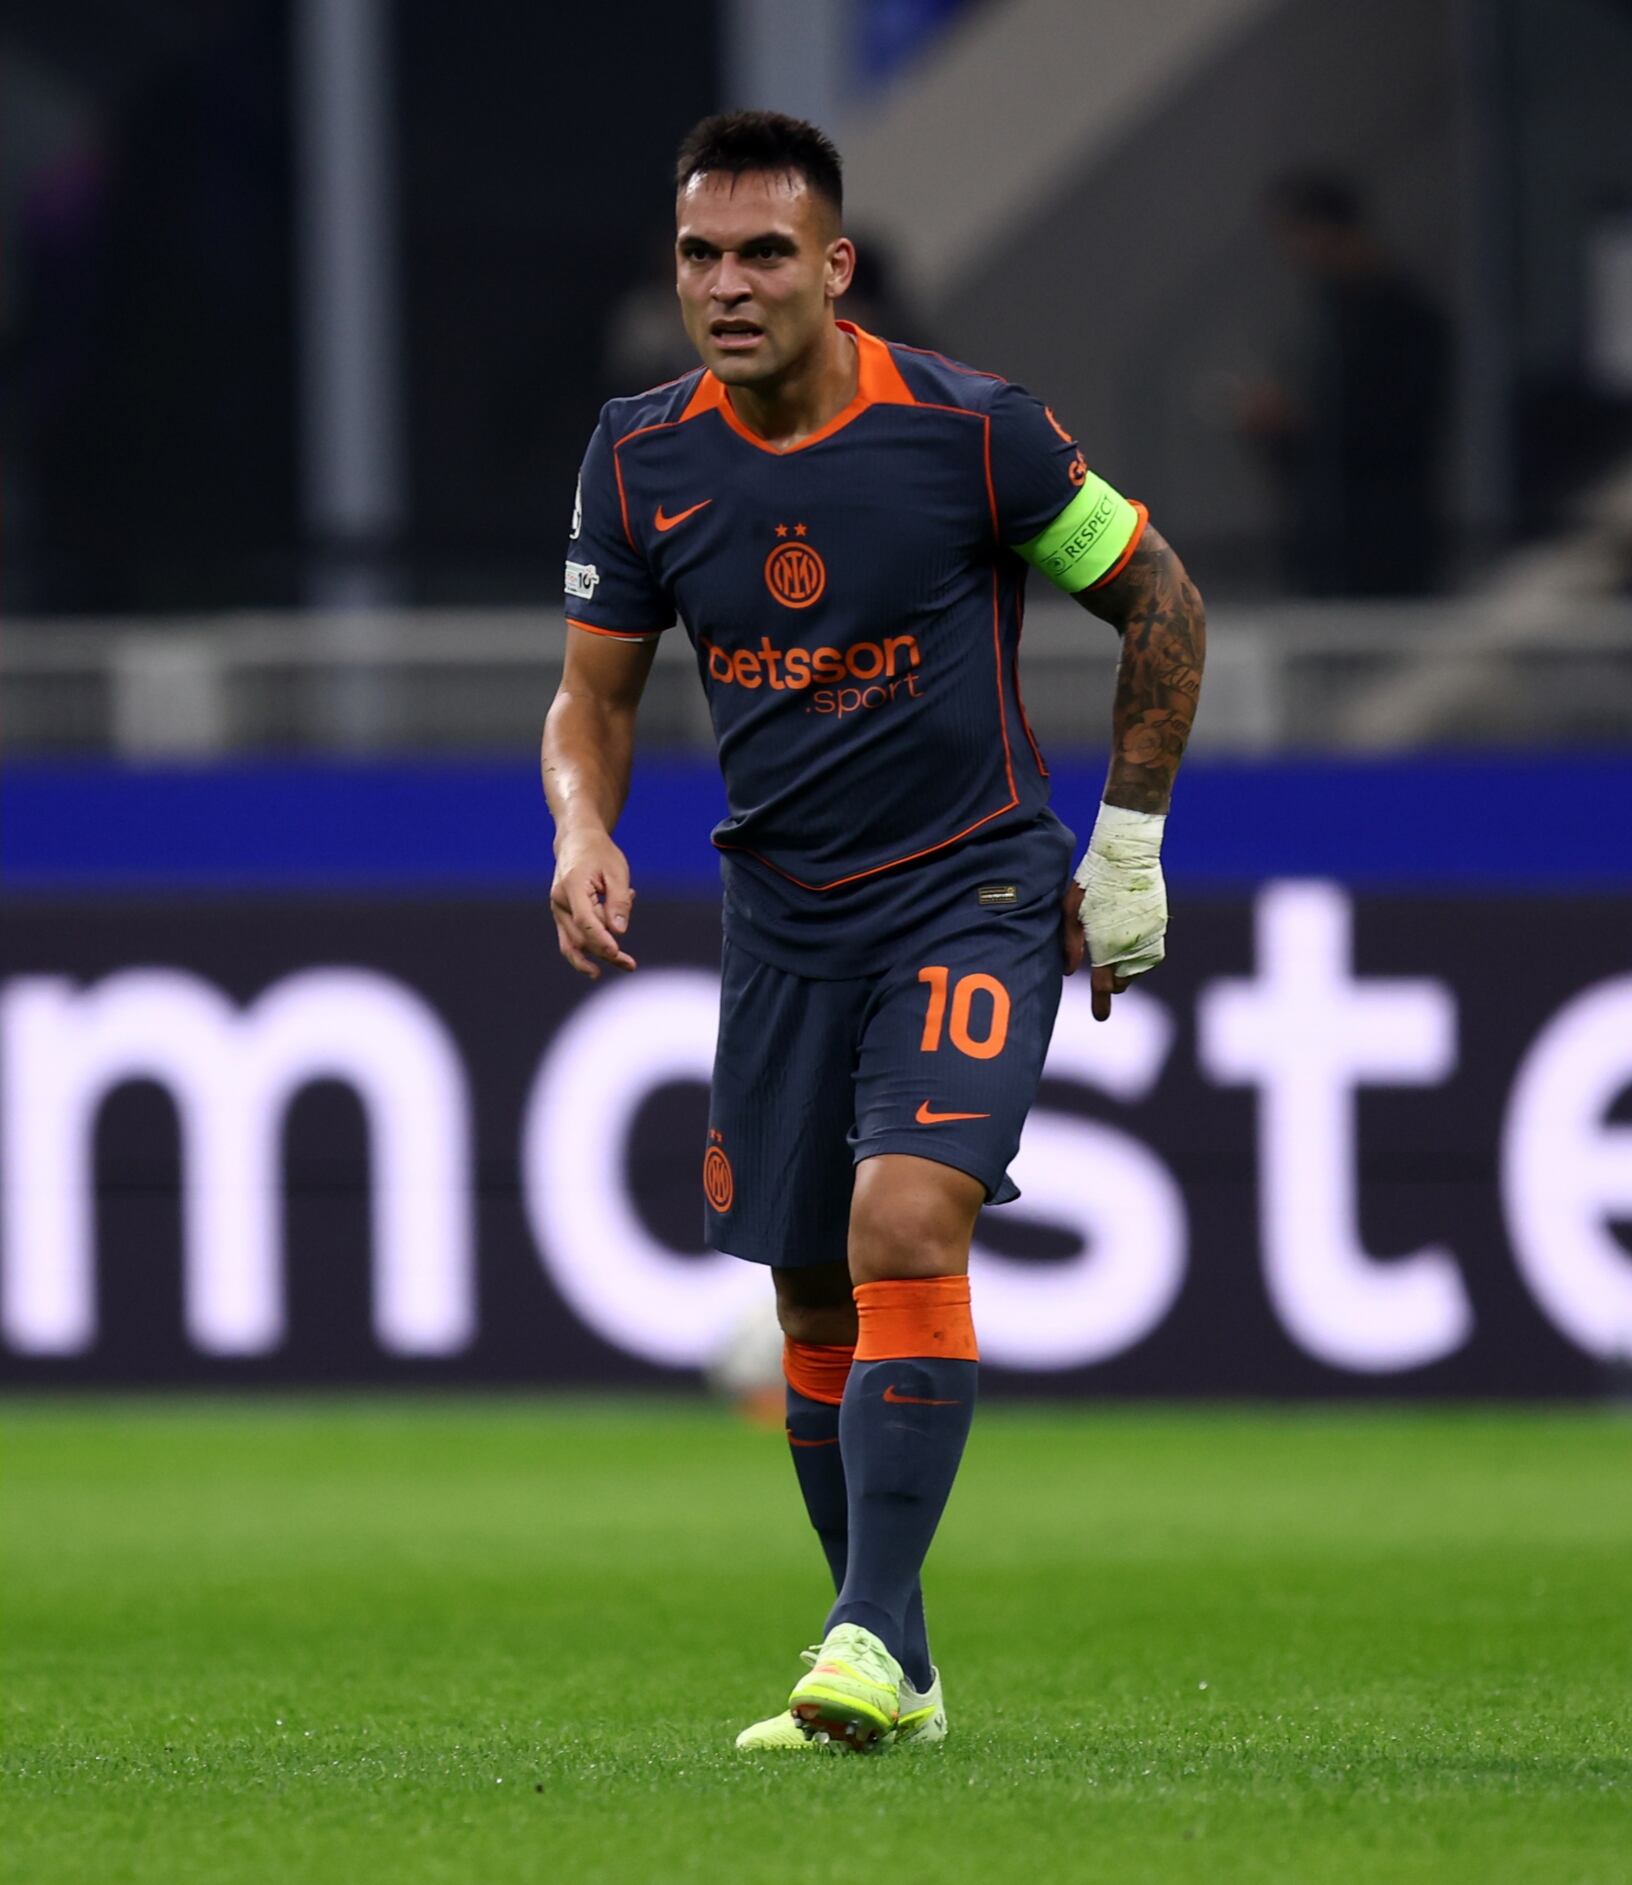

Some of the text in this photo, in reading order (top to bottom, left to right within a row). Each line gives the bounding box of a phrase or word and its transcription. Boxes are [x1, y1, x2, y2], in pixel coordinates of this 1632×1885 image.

[1064, 496, 1114, 559] RESPECT
[702, 634, 921, 690] betsson
[805, 673, 925, 720] .sport
[918, 965, 1012, 1060] 10
